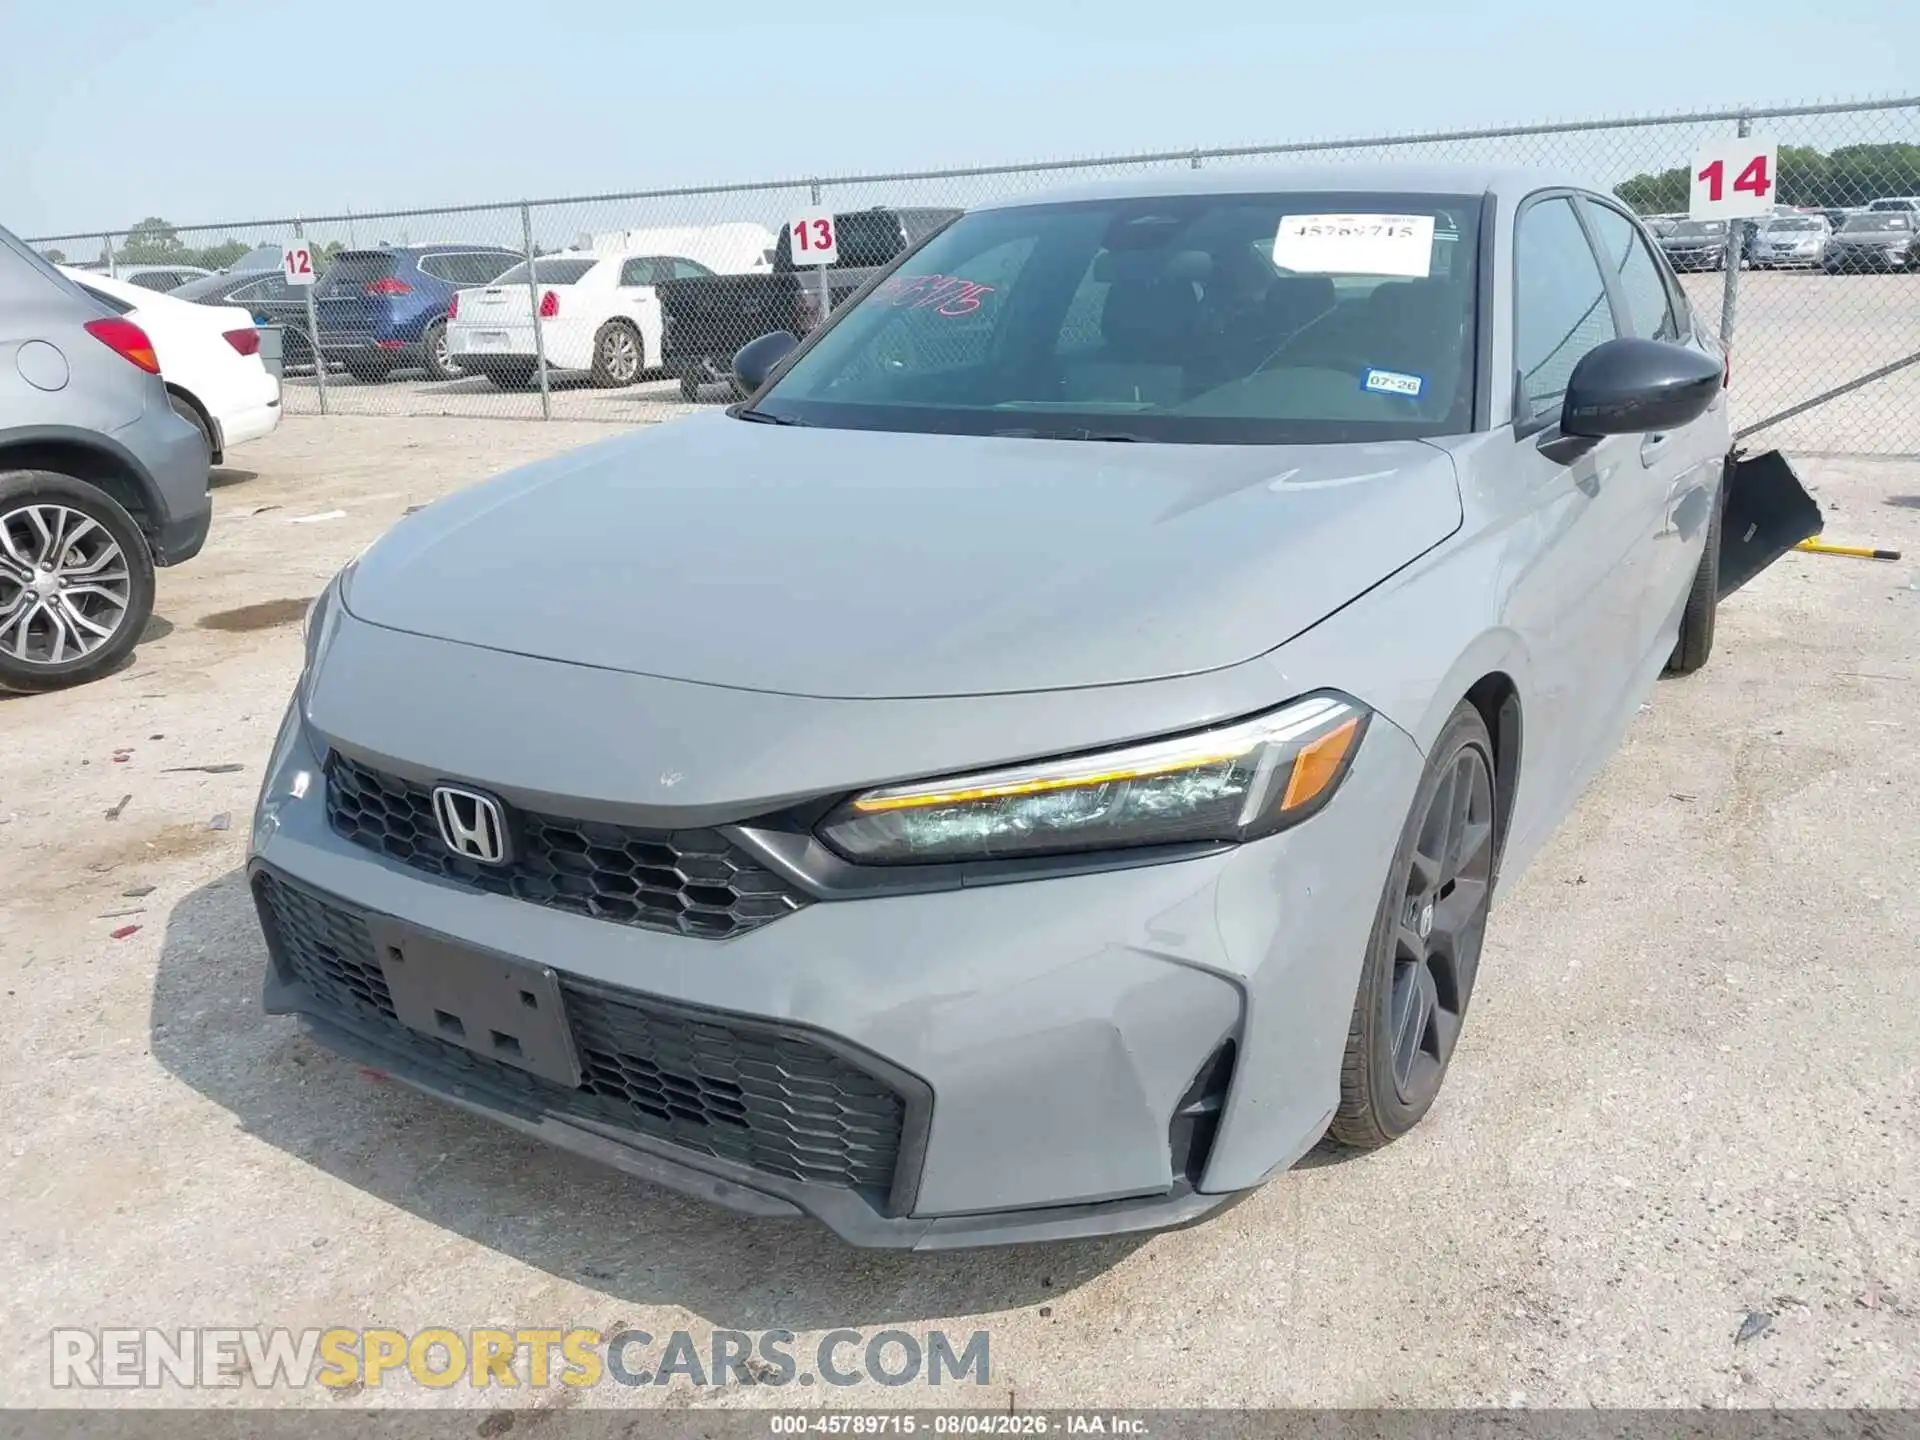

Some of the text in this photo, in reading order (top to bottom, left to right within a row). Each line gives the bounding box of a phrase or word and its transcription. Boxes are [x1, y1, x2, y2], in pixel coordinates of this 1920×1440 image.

[1698, 155, 1771, 201] 14
[794, 219, 832, 250] 13
[286, 250, 311, 274] 12
